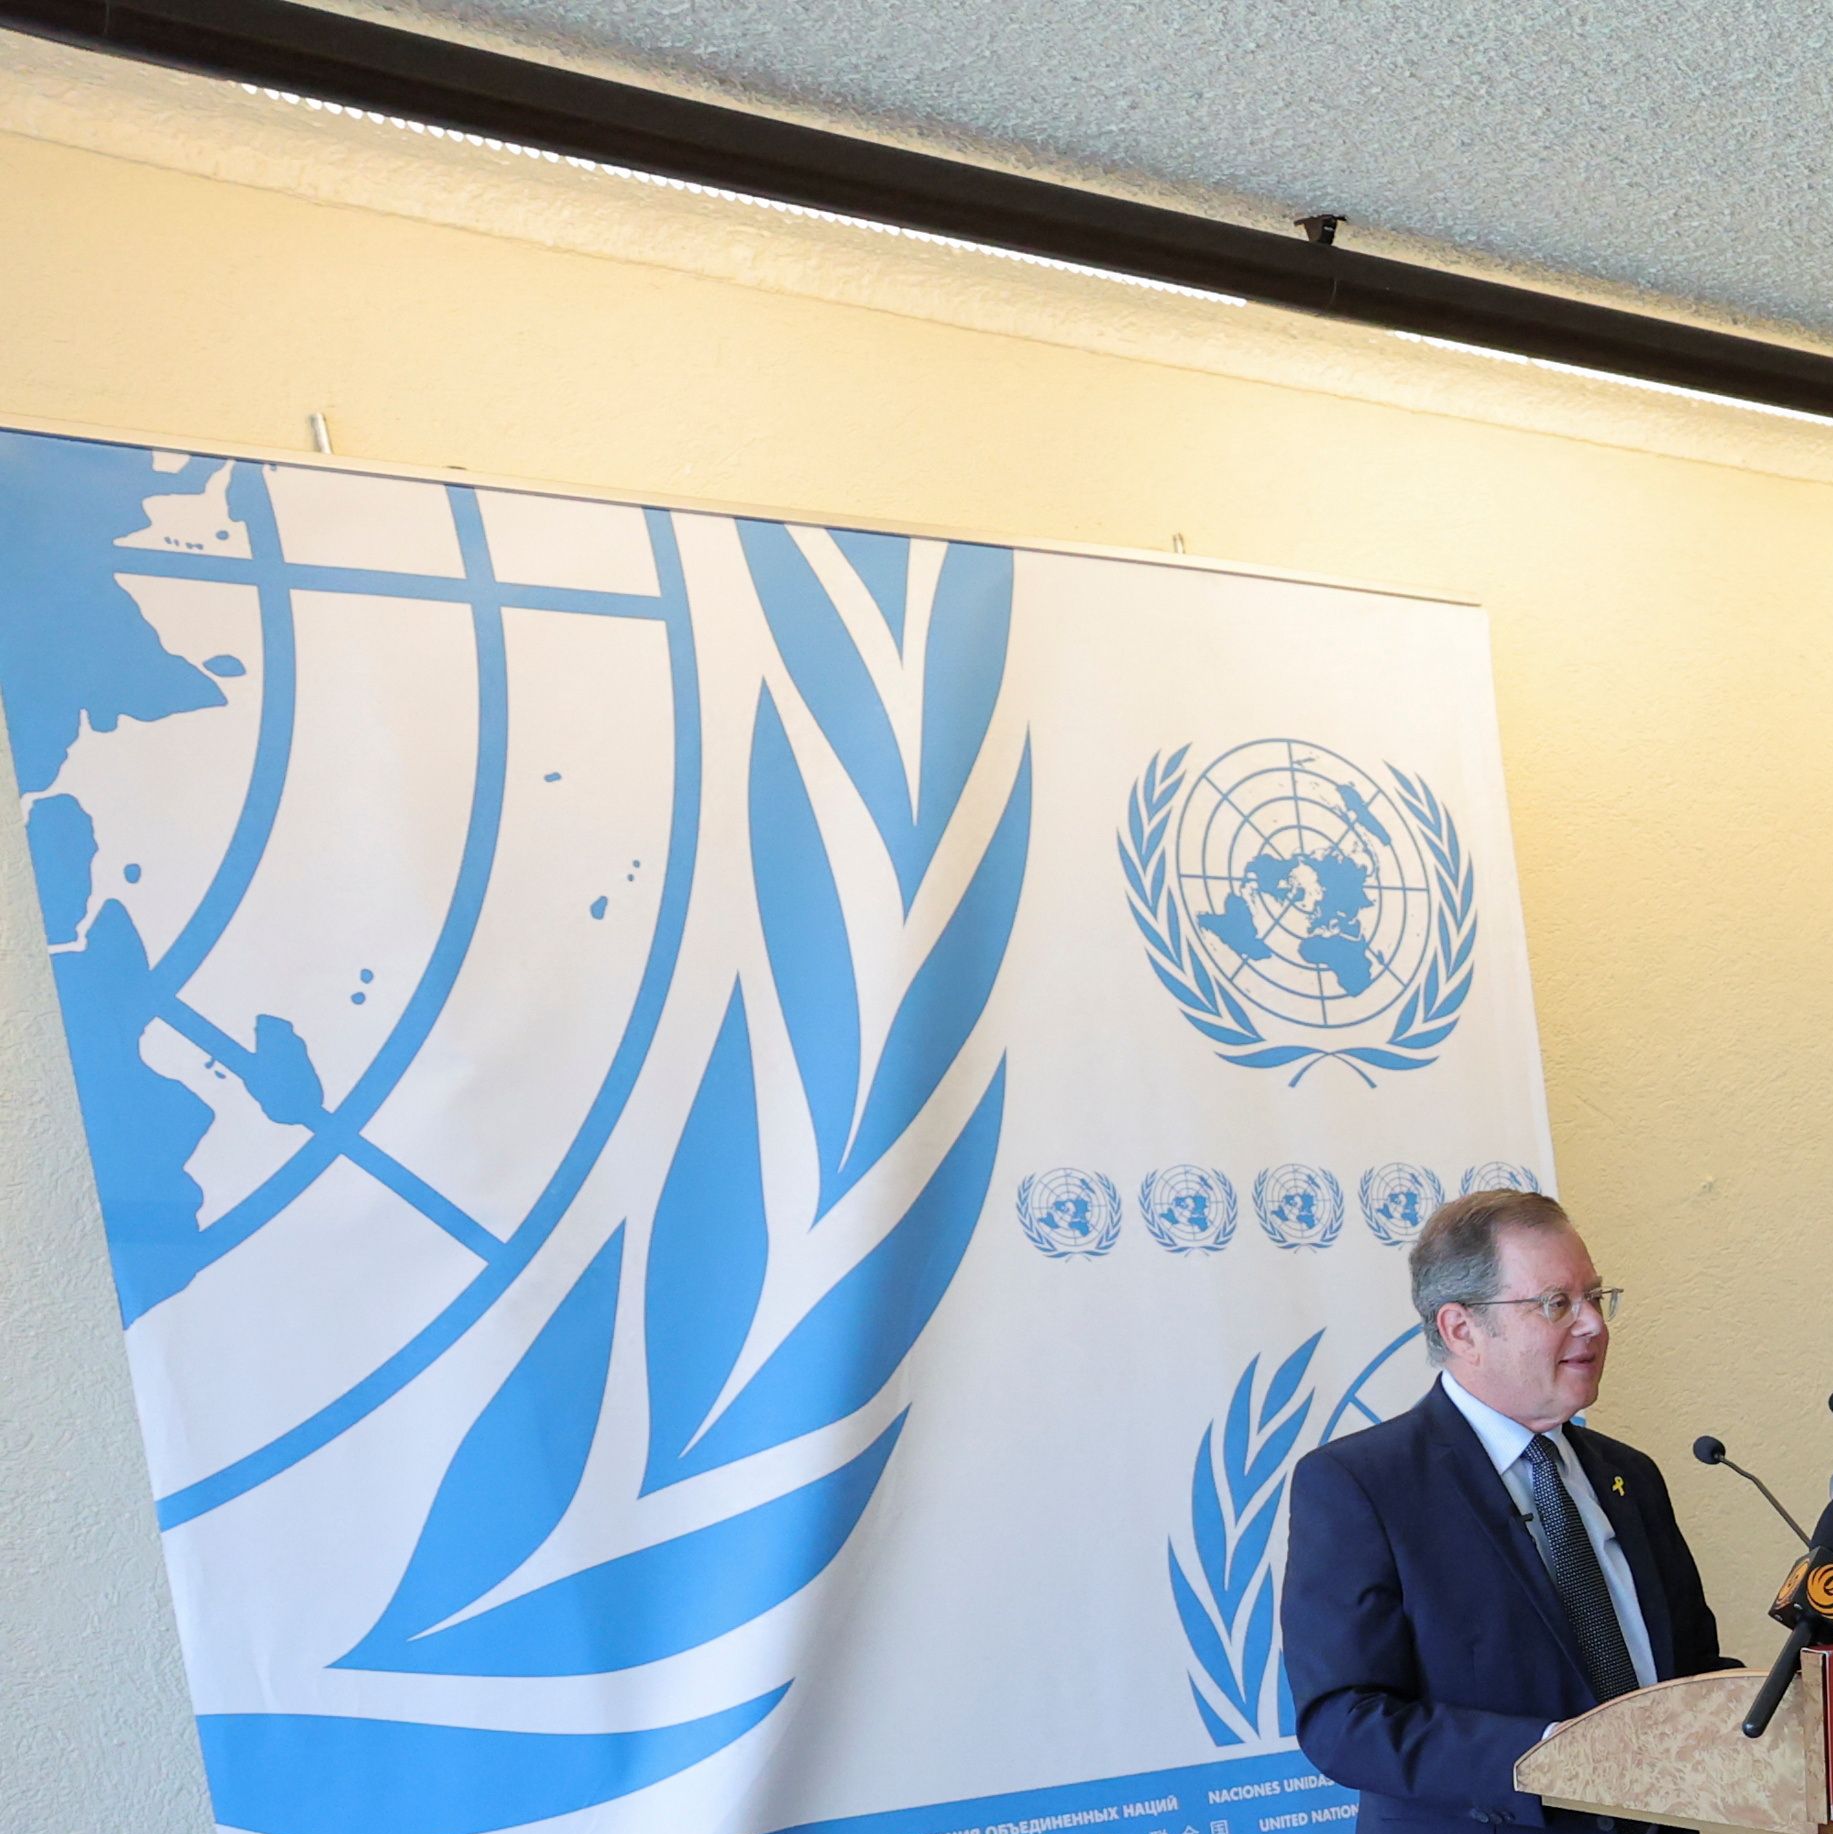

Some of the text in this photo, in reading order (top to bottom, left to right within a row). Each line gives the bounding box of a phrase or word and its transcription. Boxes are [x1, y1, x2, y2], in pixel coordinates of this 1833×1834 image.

[1206, 1779, 1282, 1806] NACIONES
[1121, 1793, 1180, 1819] НАЦИЙ
[1258, 1811, 1310, 1834] UNITED
